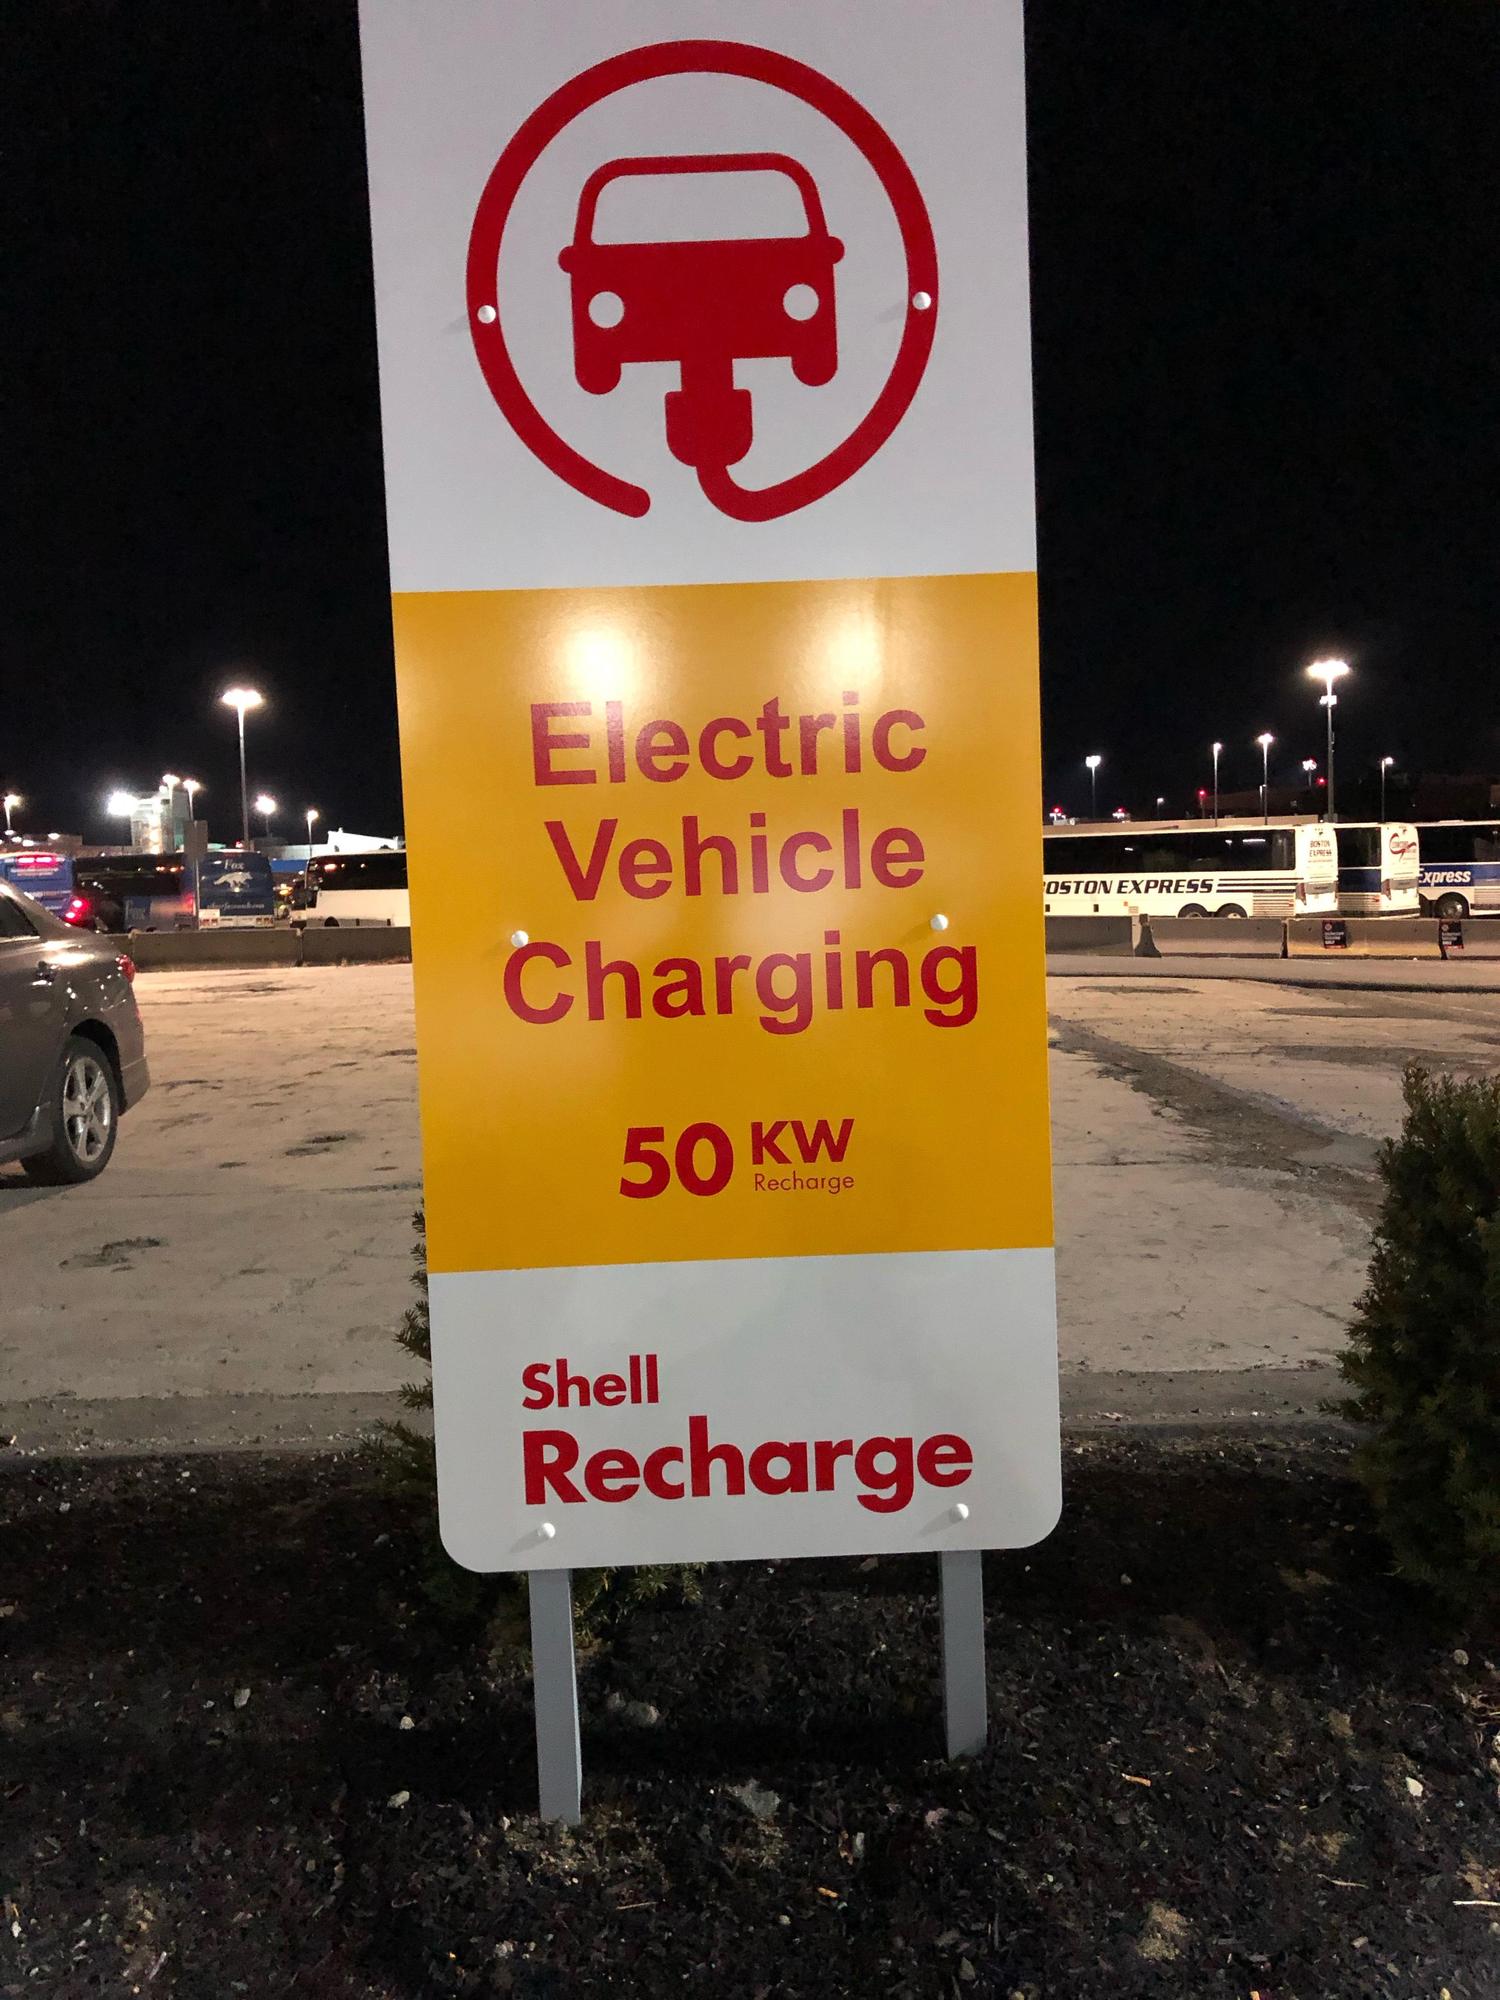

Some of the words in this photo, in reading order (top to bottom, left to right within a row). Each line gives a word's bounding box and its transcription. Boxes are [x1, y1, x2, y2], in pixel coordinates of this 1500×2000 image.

[530, 690, 928, 787] Electric
[543, 807, 926, 902] Vehicle
[1043, 880, 1113, 894] OSTON
[1116, 879, 1214, 894] EXPRESS
[502, 929, 979, 1035] Charging
[619, 1121, 734, 1200] 50
[750, 1118, 855, 1166] KW
[753, 1170, 855, 1195] Recharge
[521, 1353, 660, 1411] Shell
[522, 1415, 974, 1514] Recharge
